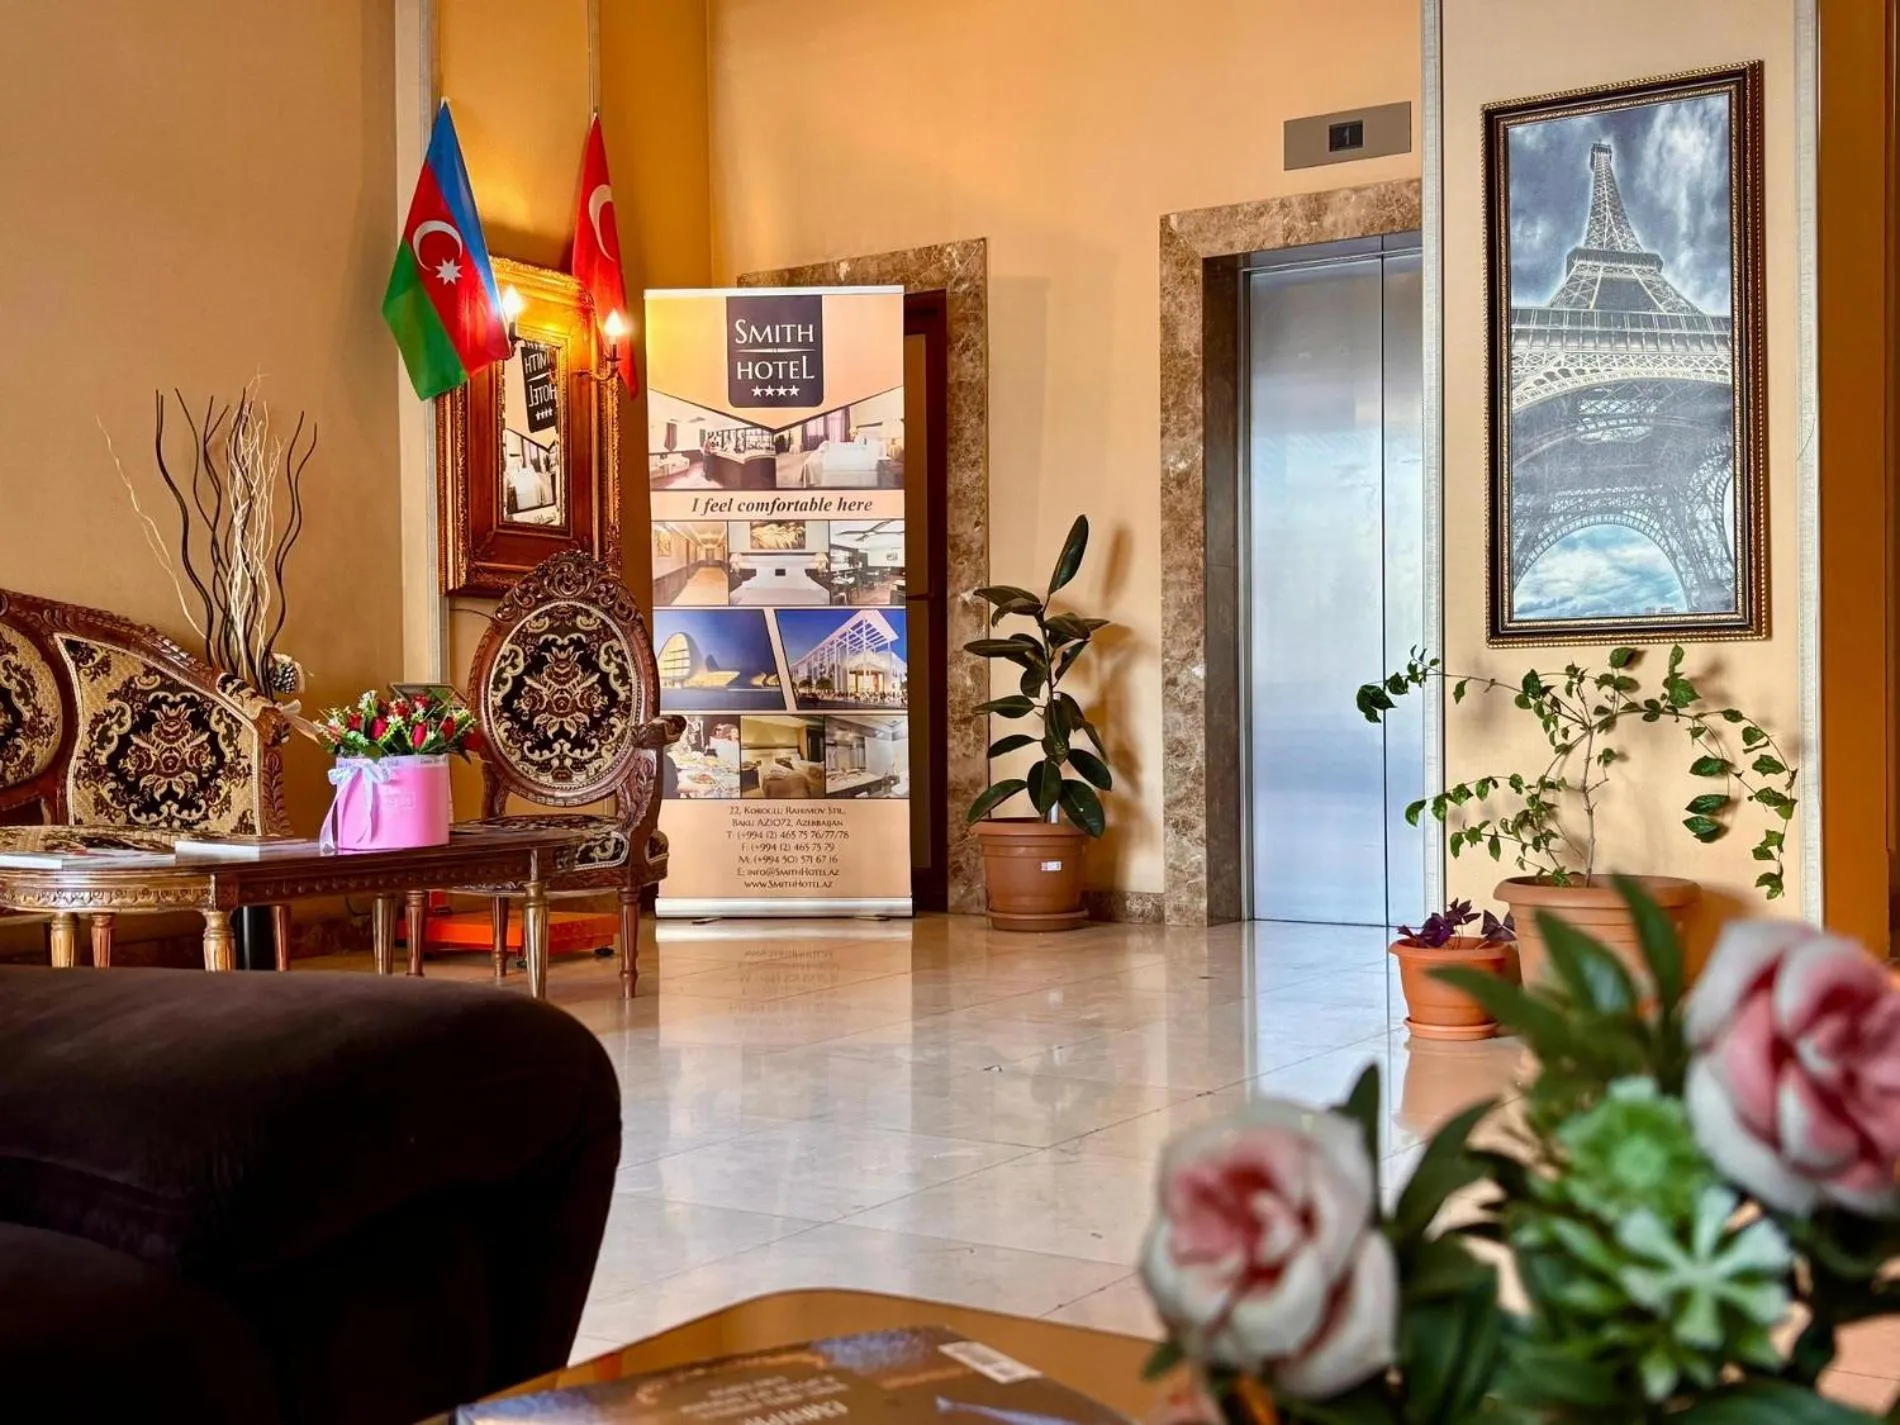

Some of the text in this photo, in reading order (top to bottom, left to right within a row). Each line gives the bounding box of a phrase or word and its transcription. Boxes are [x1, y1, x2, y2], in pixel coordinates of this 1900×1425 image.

[734, 318, 814, 344] SMITH
[736, 355, 815, 380] HOTEL
[691, 497, 873, 516] I feel comfortable here
